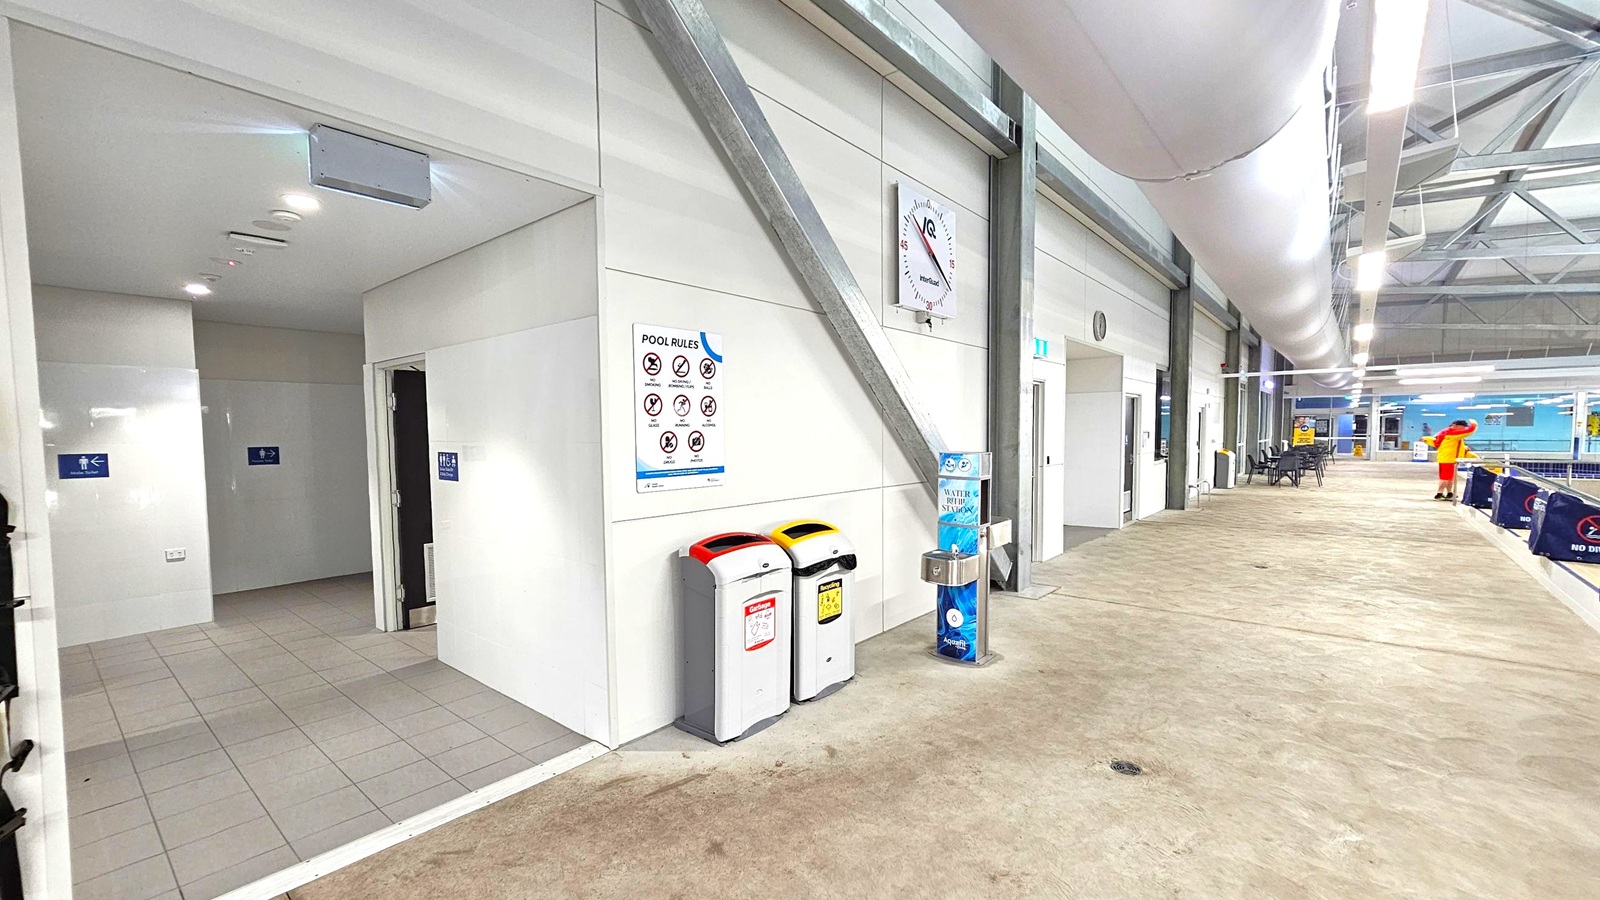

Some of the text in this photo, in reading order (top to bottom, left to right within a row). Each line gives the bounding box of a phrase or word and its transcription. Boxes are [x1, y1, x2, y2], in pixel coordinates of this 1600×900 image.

[900, 239, 909, 251] 45
[949, 259, 955, 269] 15
[925, 301, 933, 311] 30
[641, 334, 699, 350] POOL RULES
[944, 488, 971, 498] WATER
[941, 504, 974, 514] STATION
[1570, 544, 1586, 552] NO
[749, 601, 771, 613] Garbage
